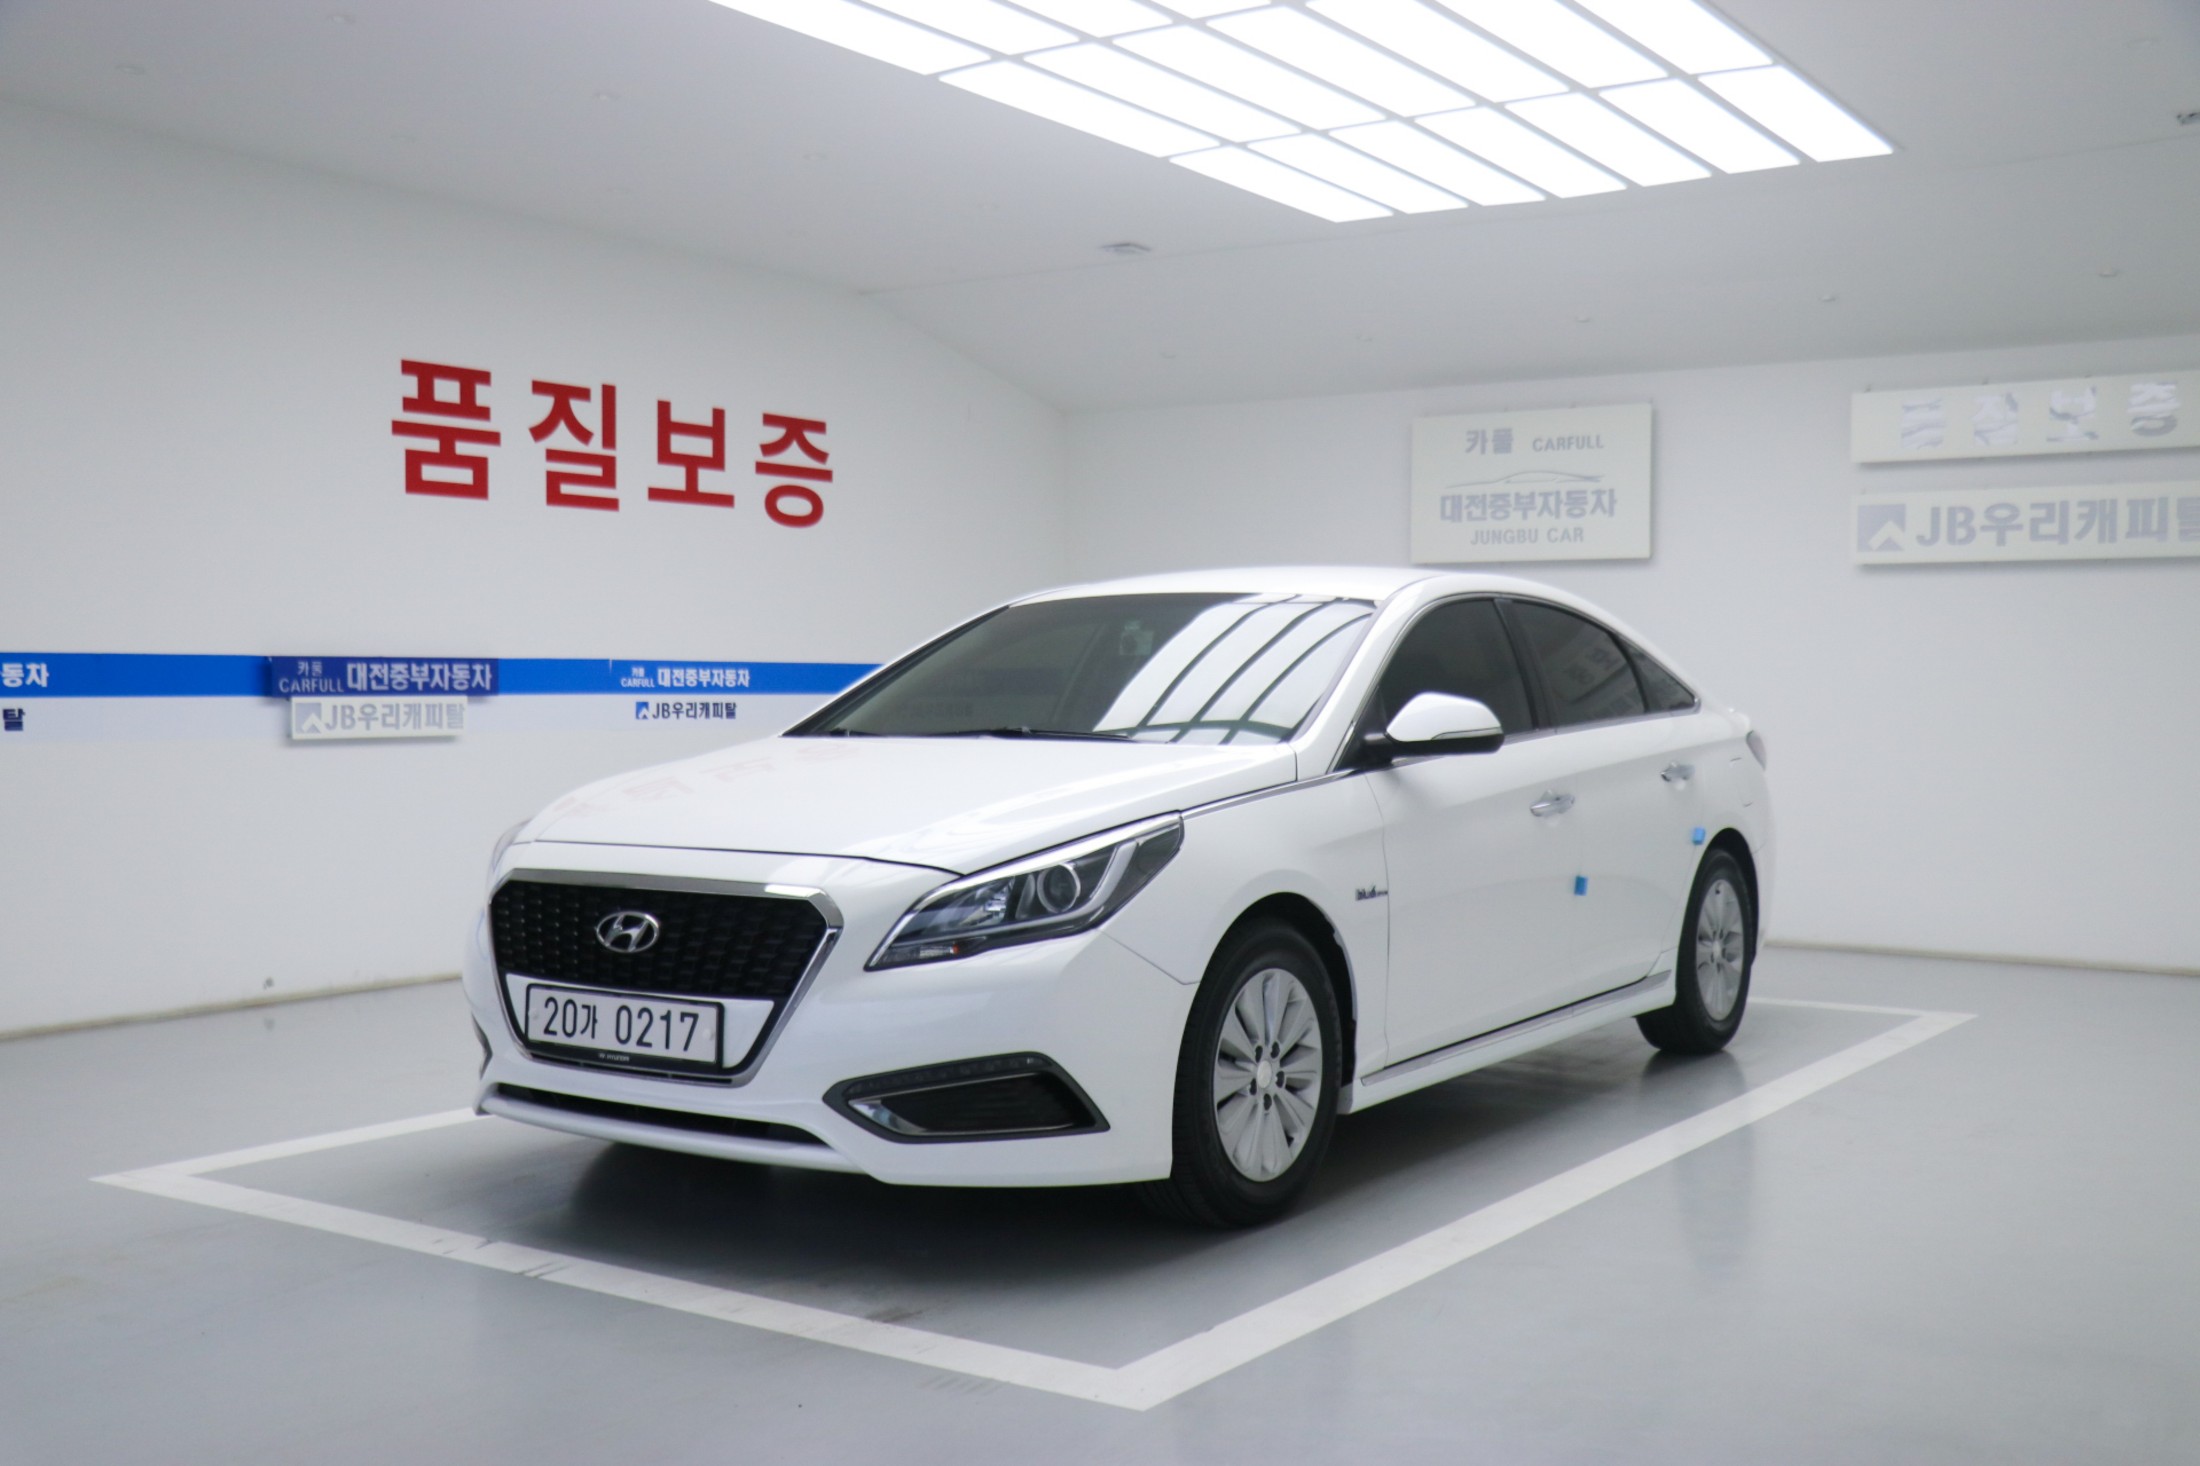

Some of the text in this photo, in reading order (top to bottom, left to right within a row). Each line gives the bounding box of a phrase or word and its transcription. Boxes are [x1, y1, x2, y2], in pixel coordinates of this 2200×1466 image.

[391, 359, 834, 529] 품질보증
[1532, 434, 1605, 453] CARFULL
[1440, 487, 1618, 523] 대전중부자동차
[1470, 526, 1585, 546] JUNGBU CAR
[0, 663, 50, 688] 동차
[279, 678, 344, 693] CARFULL
[347, 662, 492, 691] 대전중부자동차
[621, 678, 655, 688] CARFULL
[658, 667, 750, 688] 대전중부자동차
[325, 702, 466, 731] JB우리캐피탈
[652, 701, 737, 720] JB우리캐피탈
[543, 997, 699, 1052] 20가 0217
